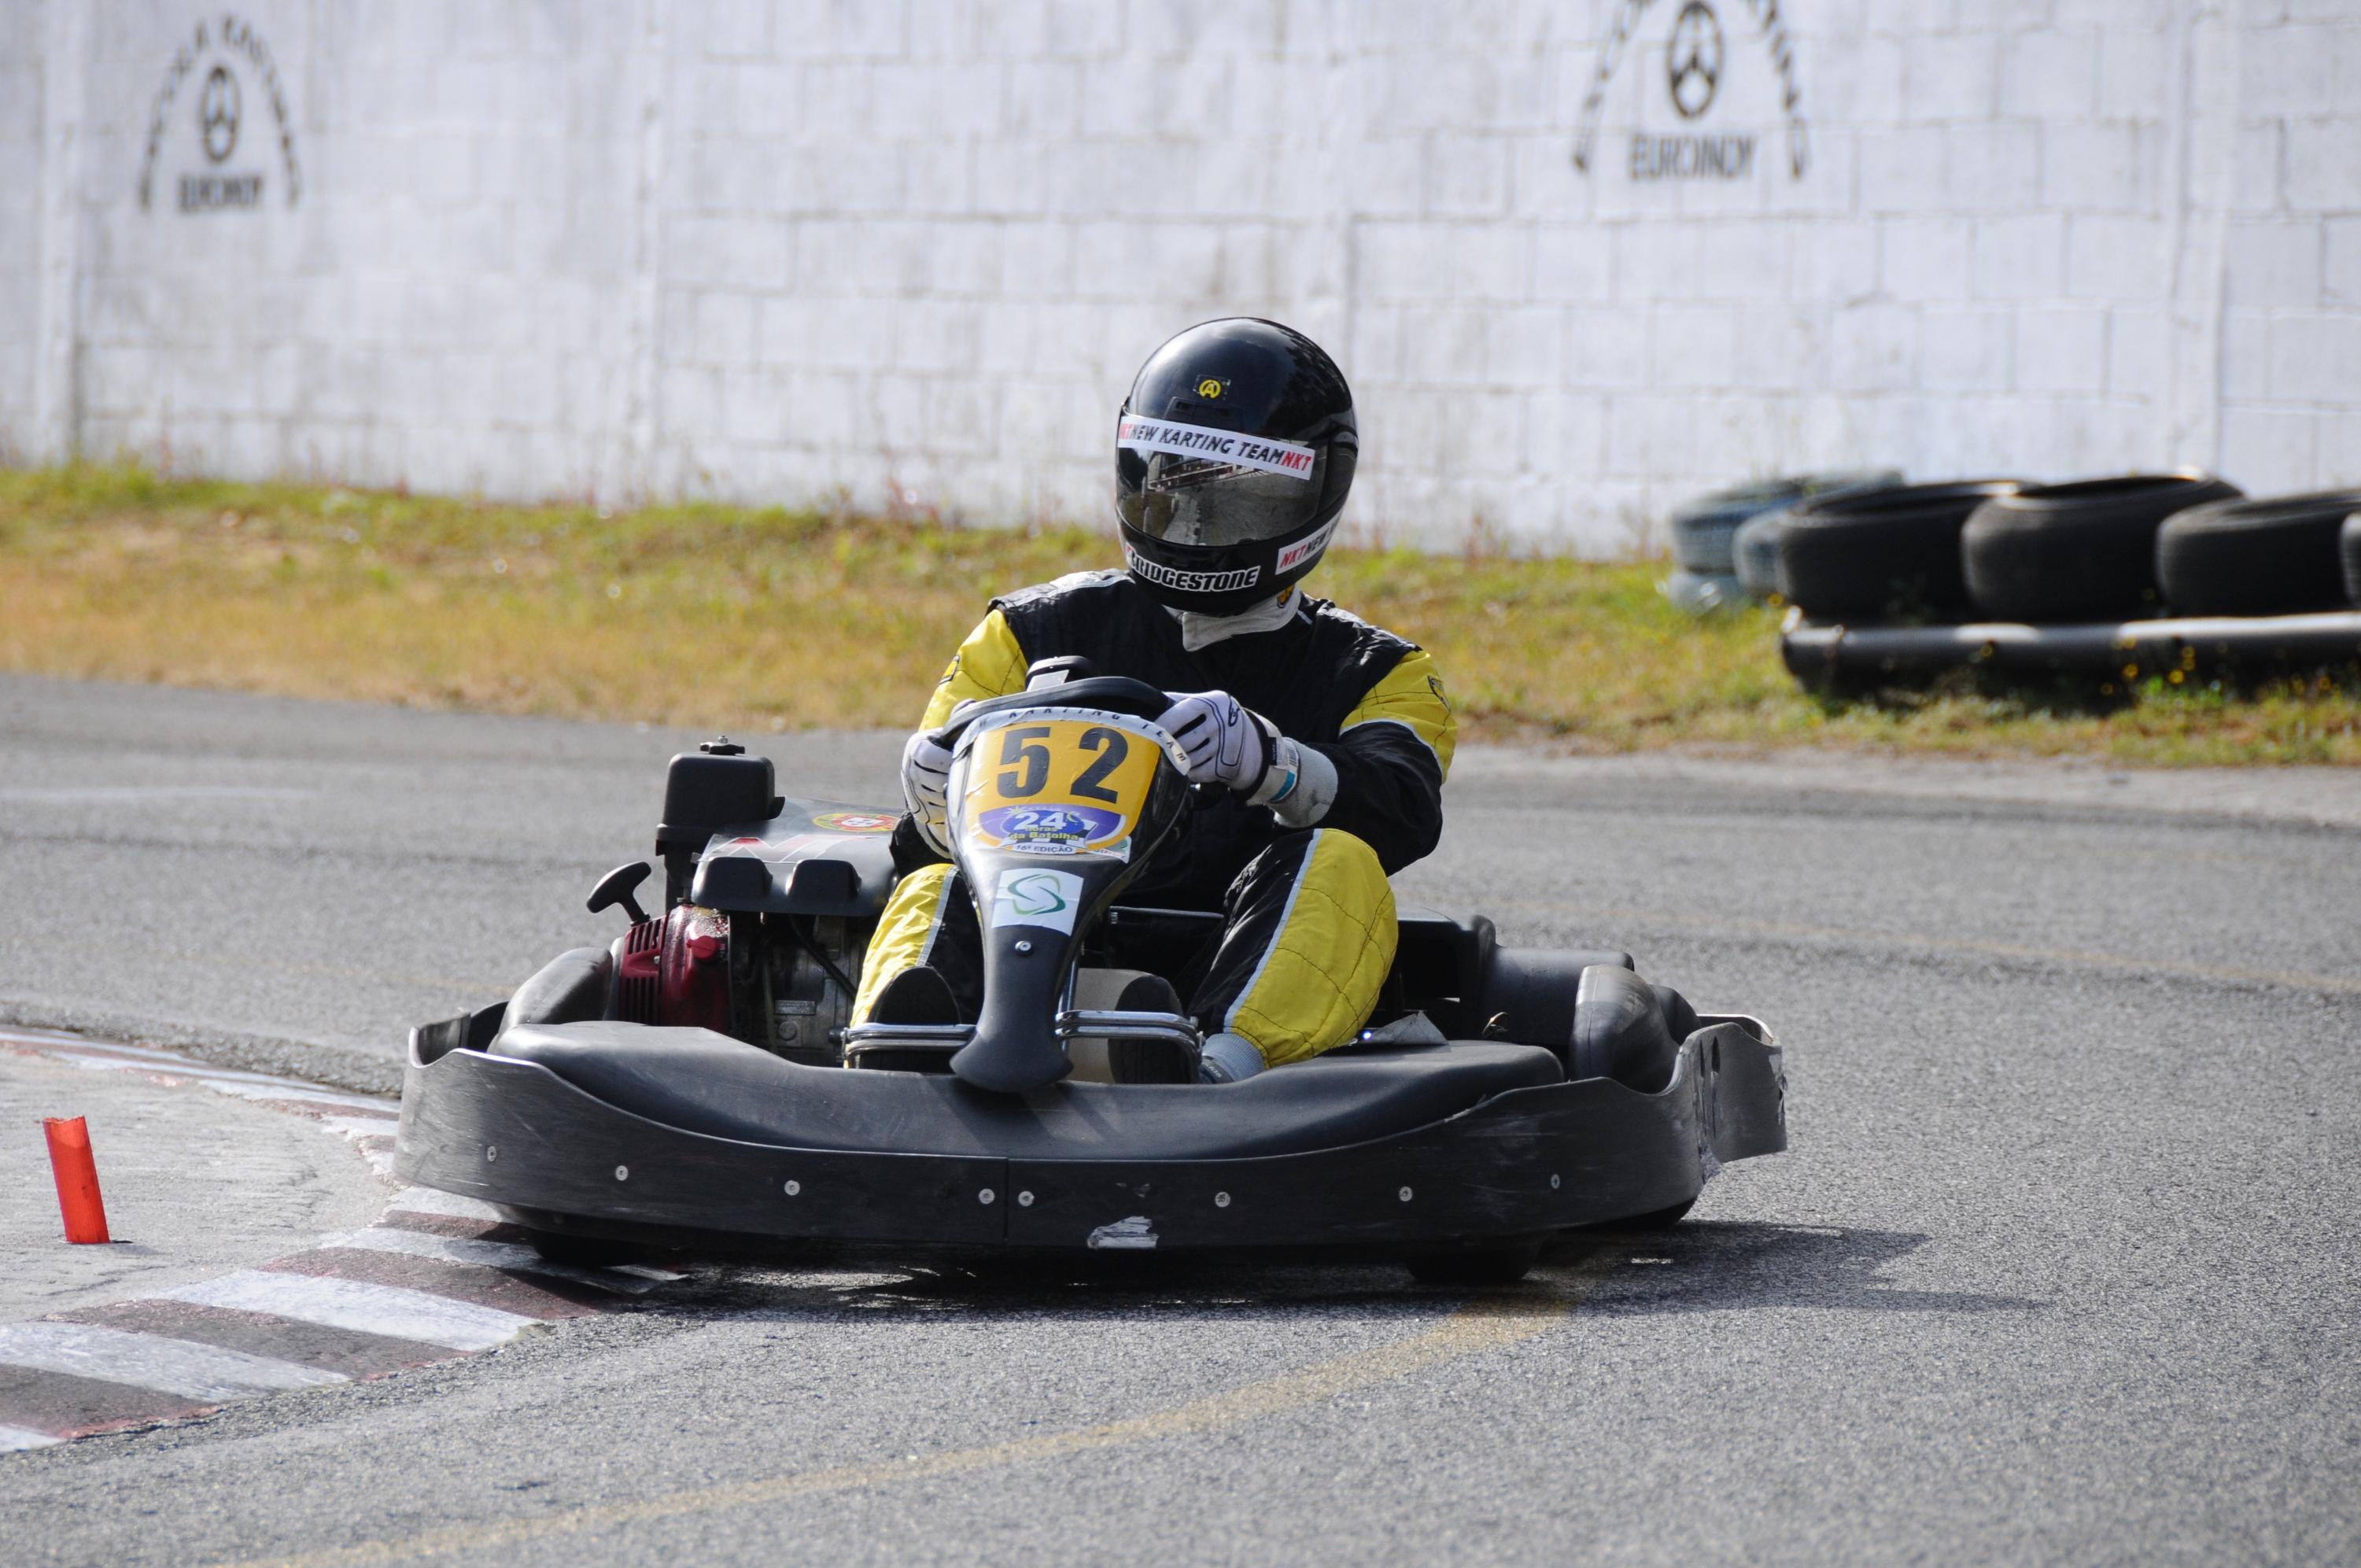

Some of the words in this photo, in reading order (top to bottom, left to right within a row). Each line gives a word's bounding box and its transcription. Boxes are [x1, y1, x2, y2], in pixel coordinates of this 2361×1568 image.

[1158, 427, 1235, 455] KARTING
[1126, 543, 1260, 592] BRIDGESTONE
[1013, 811, 1067, 831] 24
[1029, 832, 1079, 841] Batalha
